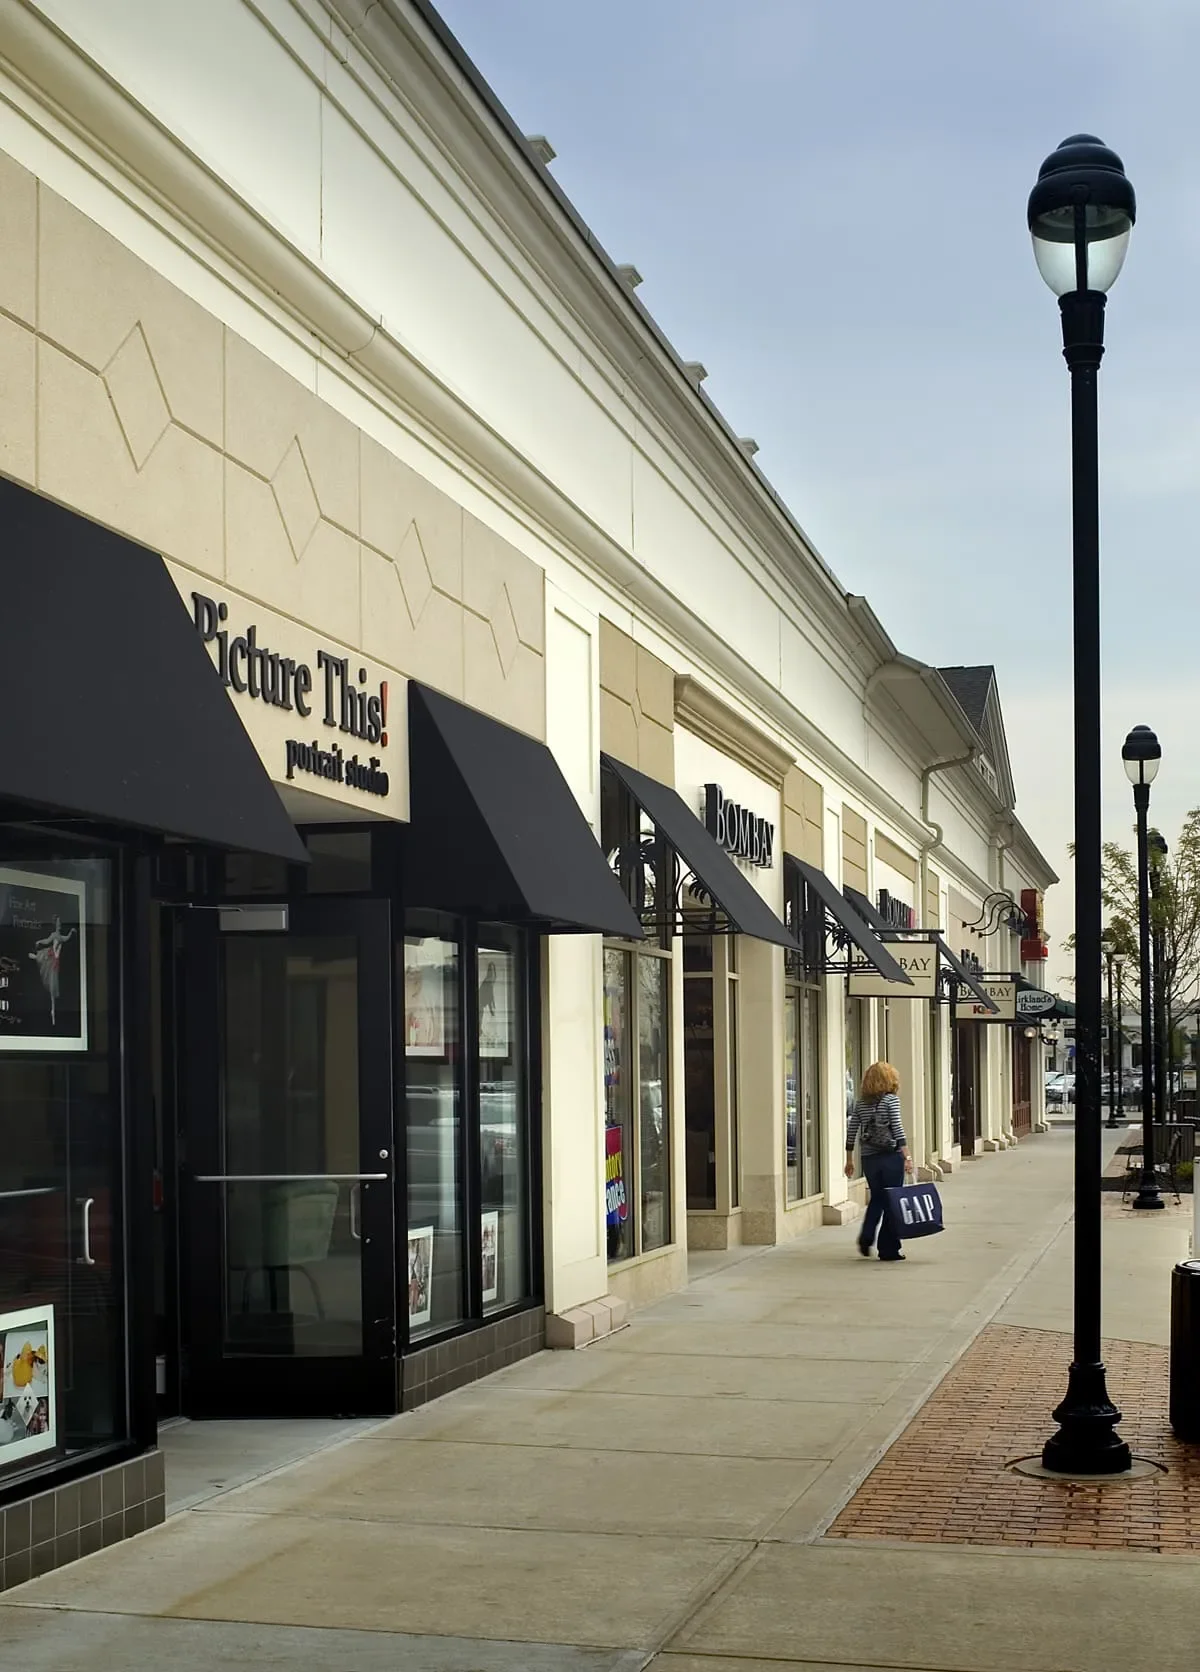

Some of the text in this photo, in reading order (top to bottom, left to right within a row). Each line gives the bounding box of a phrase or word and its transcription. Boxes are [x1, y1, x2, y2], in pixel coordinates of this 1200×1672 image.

[191, 591, 388, 748] Picture This!
[285, 739, 389, 797] portrait studio
[705, 784, 774, 868] BOMBAY
[856, 955, 931, 971] BBAY
[1018, 994, 1052, 1003] irkland's
[1020, 1003, 1043, 1011] Home
[900, 1194, 935, 1225] GAP
